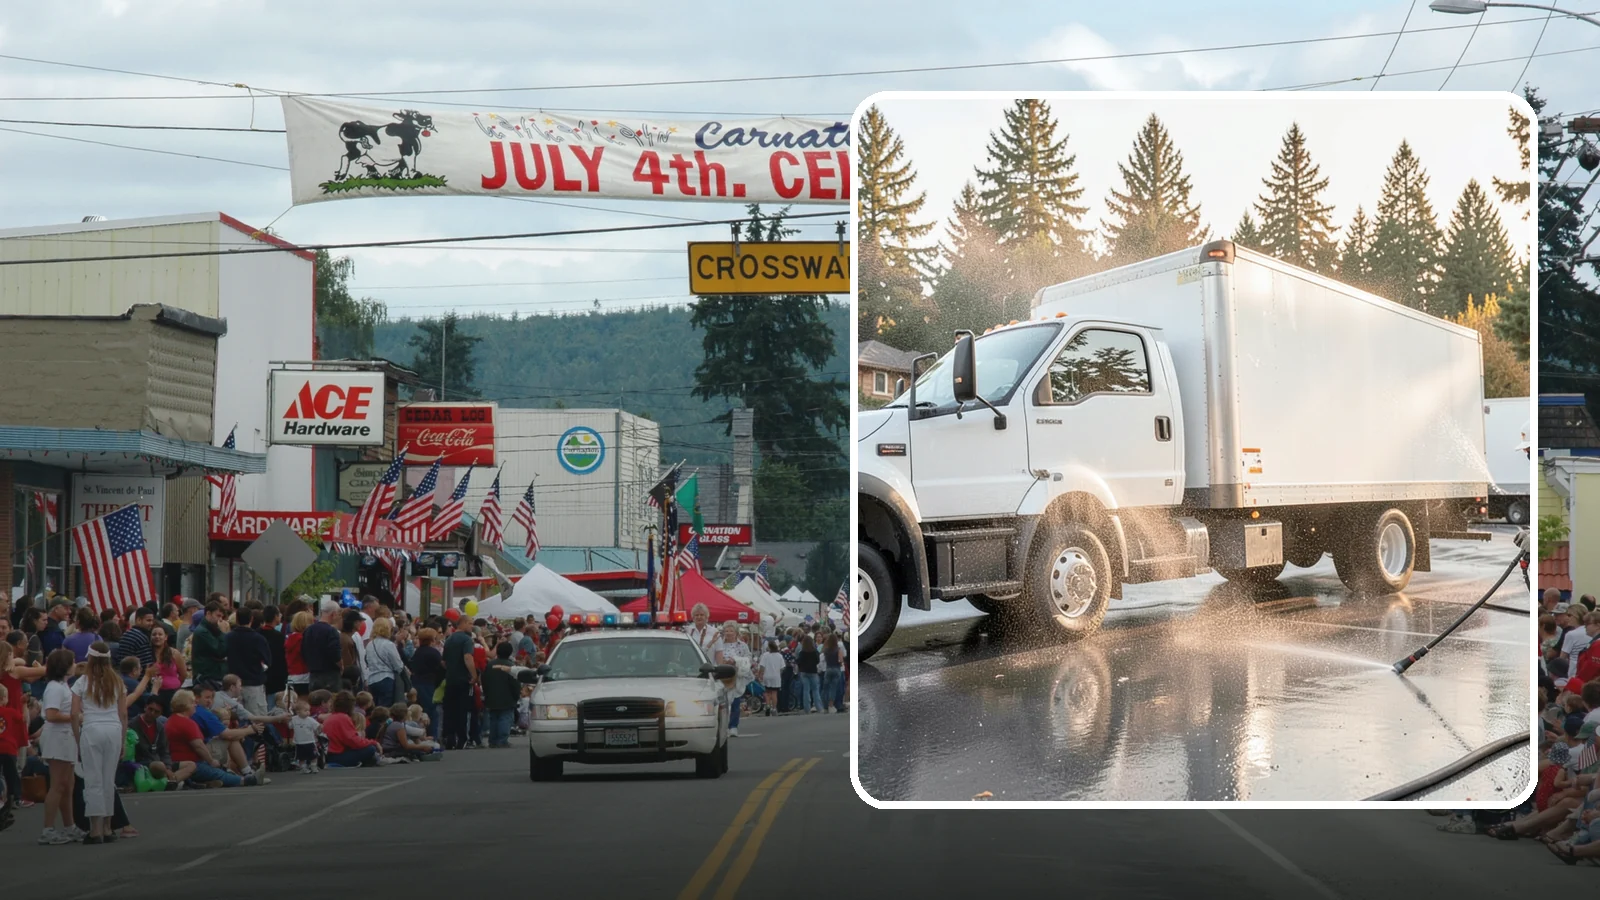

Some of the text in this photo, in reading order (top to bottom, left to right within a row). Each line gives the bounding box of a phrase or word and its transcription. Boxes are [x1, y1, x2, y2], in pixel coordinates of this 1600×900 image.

[695, 121, 850, 150] Carnat
[481, 141, 605, 191] JULY
[632, 150, 746, 197] 4th.
[697, 254, 850, 280] CROSSWA
[283, 380, 373, 420] ACE
[405, 410, 485, 422] CEDAR LOG
[283, 421, 371, 437] Hardware
[416, 428, 477, 447] Coca-Cola
[83, 485, 155, 495] St. Vincent de Paul
[212, 516, 331, 535] HARDARE
[688, 526, 741, 535] CRNATION
[699, 535, 730, 543] GLASS
